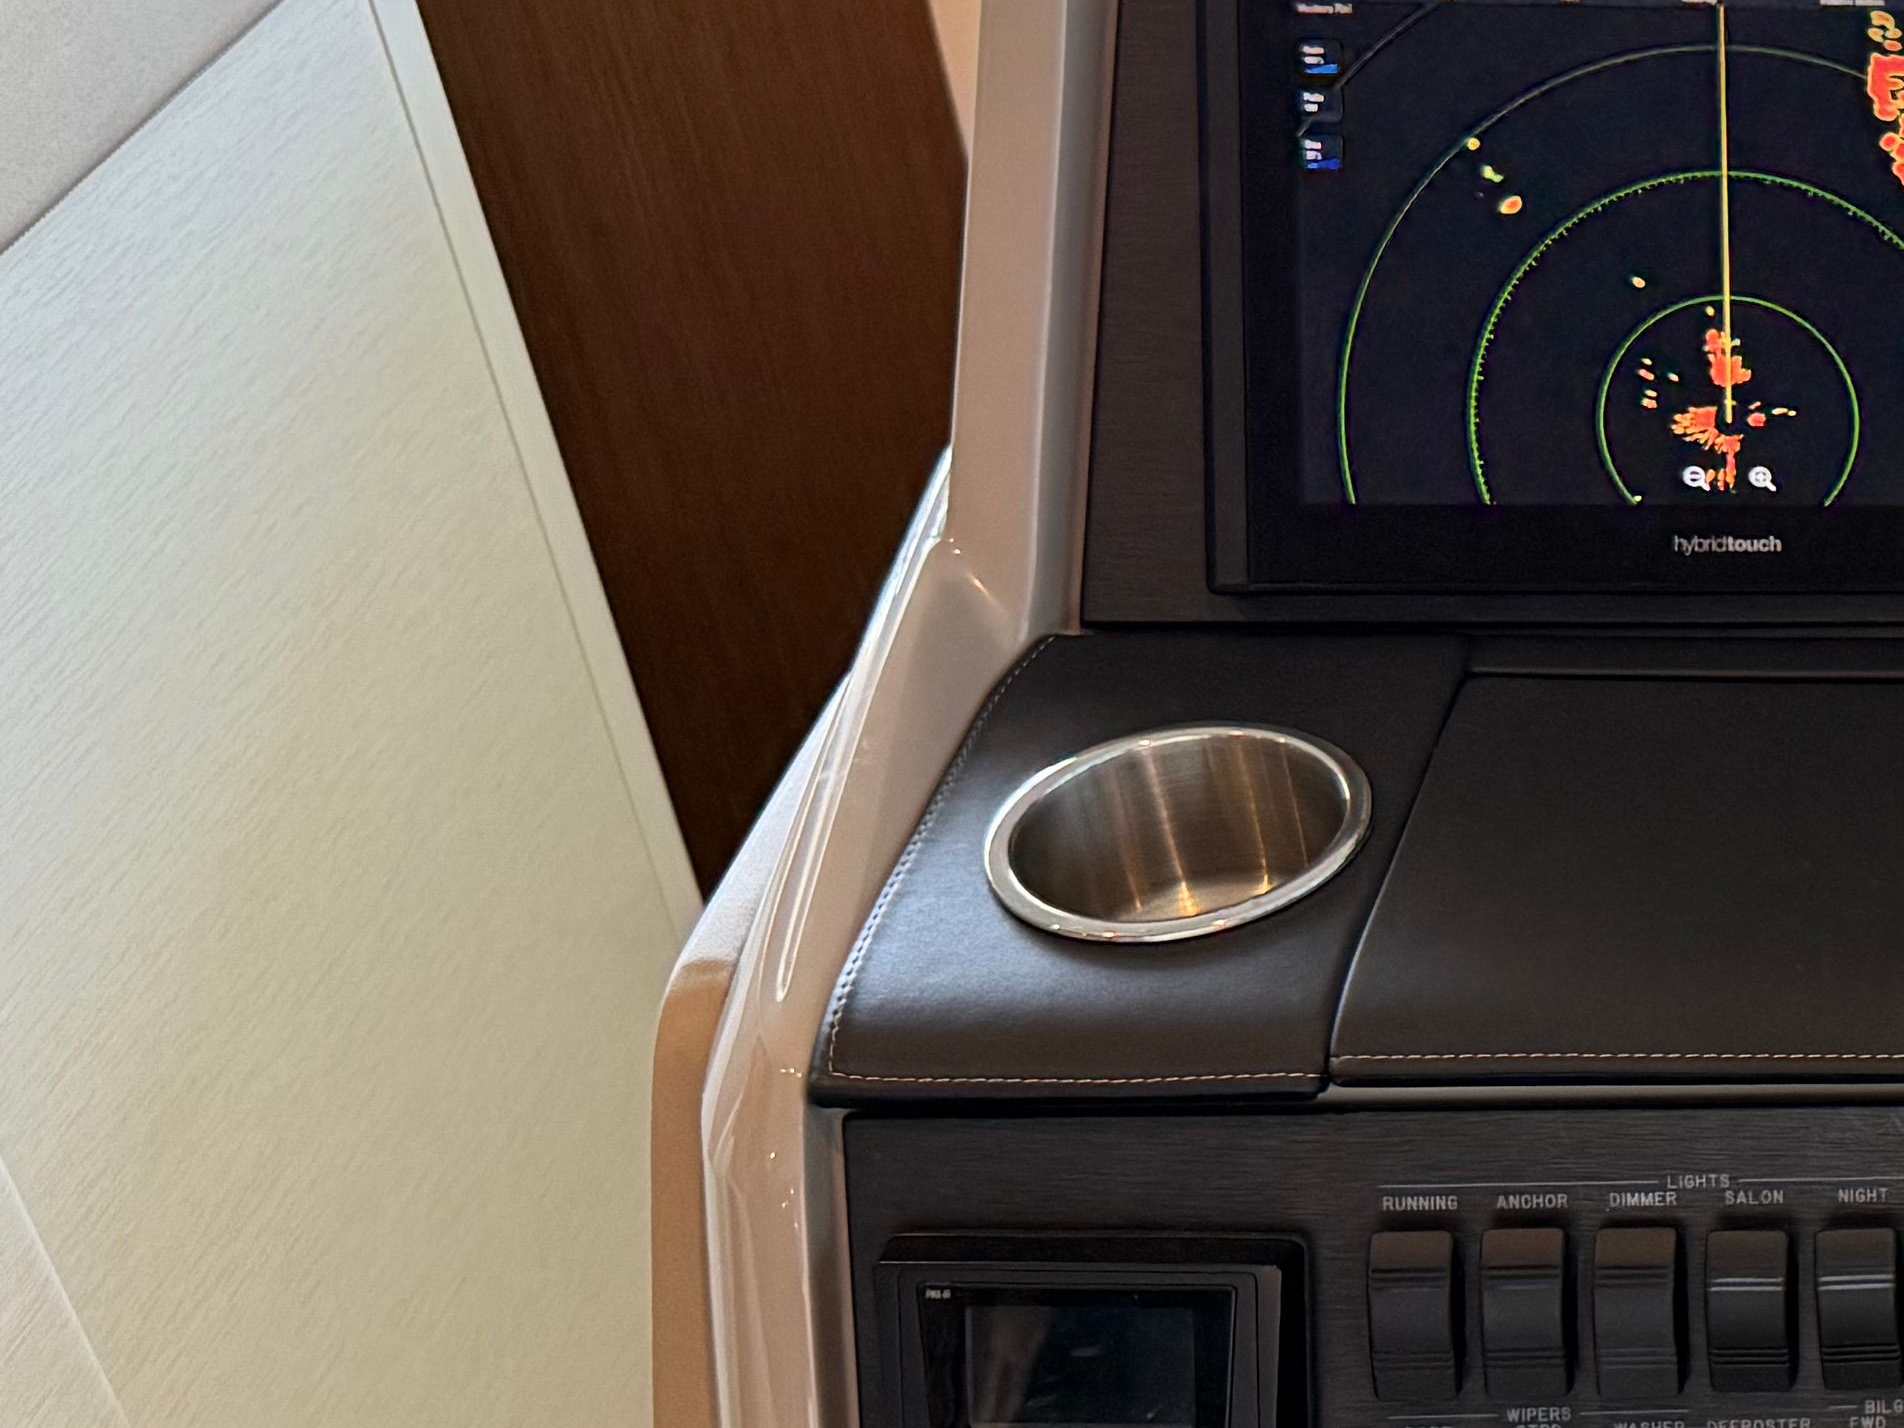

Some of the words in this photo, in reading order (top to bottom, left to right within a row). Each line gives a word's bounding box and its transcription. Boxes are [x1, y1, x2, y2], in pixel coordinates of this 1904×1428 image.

[1674, 535, 1782, 556] hybridtouch
[1667, 1174, 1730, 1189] LIGHTS
[1497, 1194, 1568, 1209] ANCHOR
[1609, 1192, 1677, 1207] DIMMER
[1725, 1190, 1784, 1205] SALON
[1838, 1188, 1888, 1203] NIGHT
[1383, 1196, 1458, 1211] RUNNING
[1507, 1407, 1572, 1422] WIPERS
